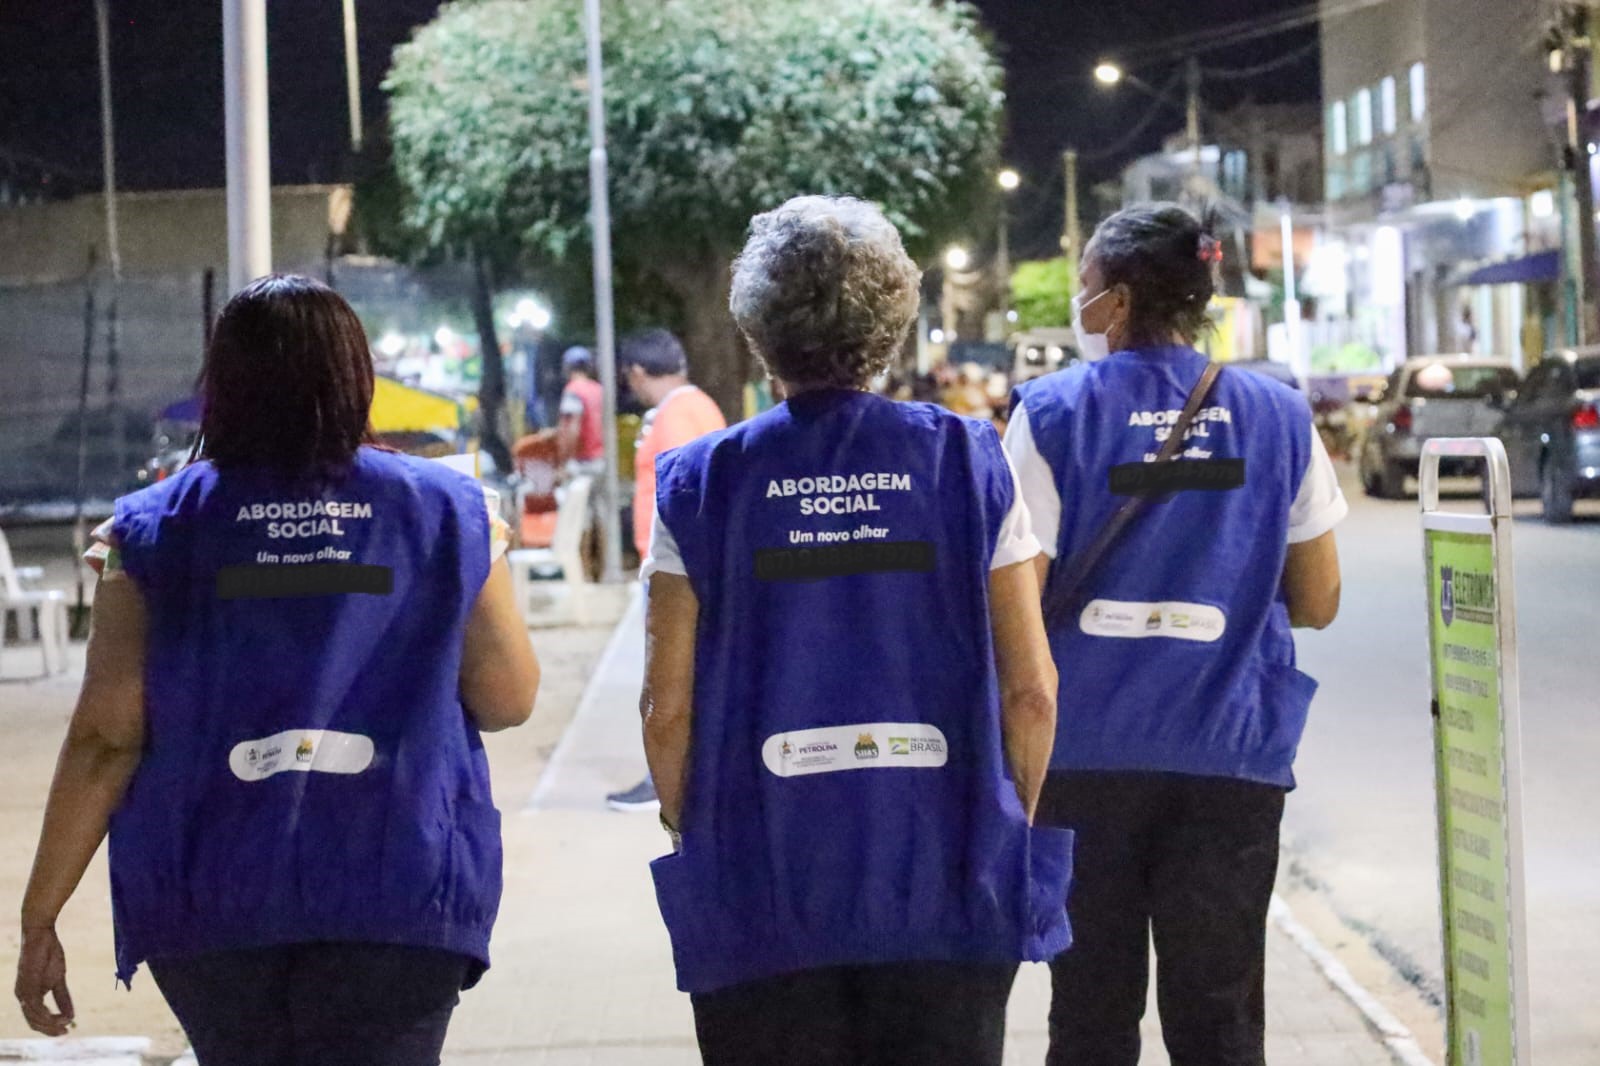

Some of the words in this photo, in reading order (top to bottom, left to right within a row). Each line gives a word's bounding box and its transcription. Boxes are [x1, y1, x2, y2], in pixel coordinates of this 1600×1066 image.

[765, 473, 912, 498] ABORDAGEM
[236, 501, 373, 522] ABORDAGEM
[800, 493, 881, 516] SOCIAL
[267, 519, 345, 539] SOCIAL
[789, 530, 814, 544] Um
[817, 530, 850, 542] novo
[852, 524, 890, 540] olhar
[256, 551, 279, 564] Um
[282, 552, 314, 564] novo
[316, 546, 352, 560] olhar
[910, 742, 944, 753] BRASIL
